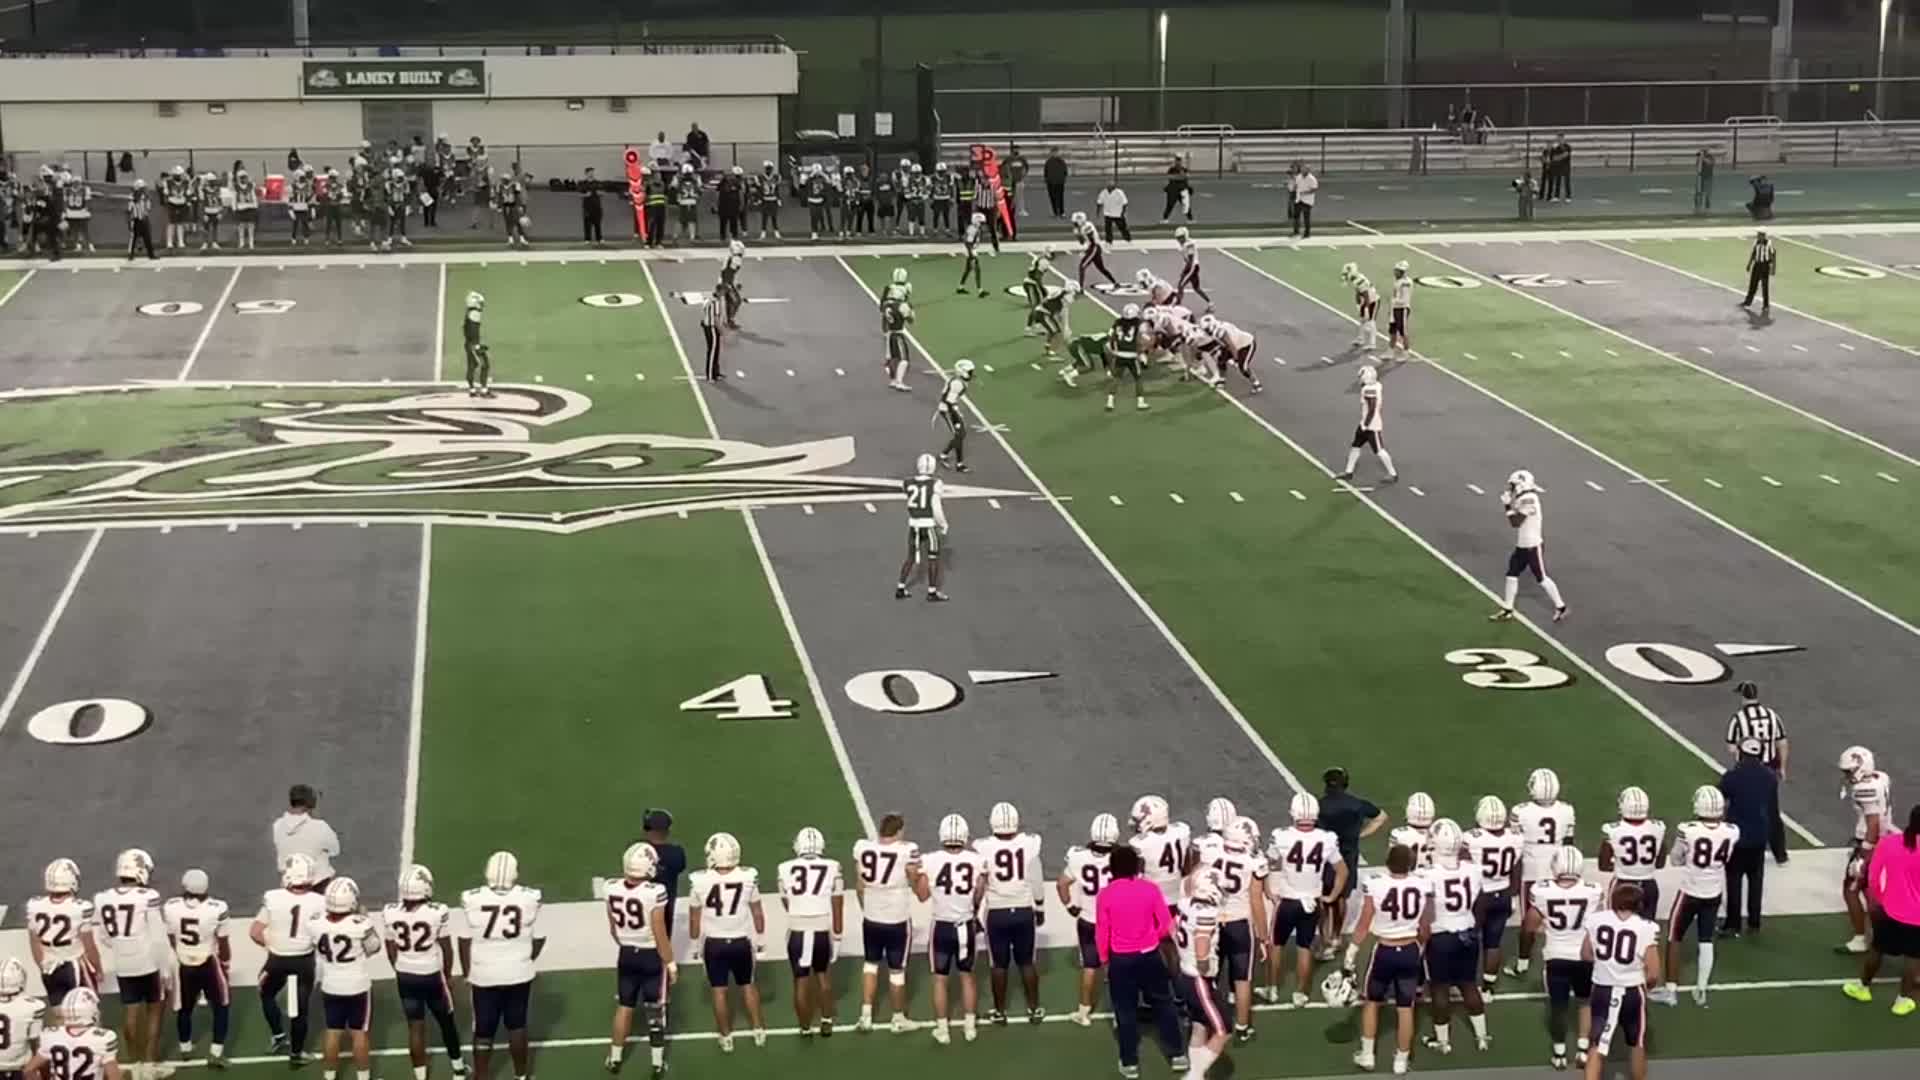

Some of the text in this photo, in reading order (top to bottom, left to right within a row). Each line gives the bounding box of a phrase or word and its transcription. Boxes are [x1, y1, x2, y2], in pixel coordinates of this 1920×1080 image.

[346, 71, 443, 84] LANEY BUILT
[907, 485, 928, 509] 21
[27, 698, 150, 745] 0
[1538, 816, 1557, 844] 3
[860, 850, 898, 885] 97
[994, 847, 1025, 882] 91
[1286, 840, 1324, 874] 44
[1481, 846, 1518, 881] 50
[1619, 834, 1658, 867] 33
[1691, 836, 1730, 869] 84
[789, 864, 828, 897] 37
[935, 861, 974, 896] 43
[1443, 877, 1474, 913] 51
[609, 897, 646, 931] 59
[704, 882, 743, 917] 47
[1380, 887, 1422, 921] 40
[1546, 898, 1589, 932] 57
[34, 912, 73, 948] 22
[100, 903, 135, 938] 87
[179, 917, 201, 947] 5
[288, 905, 301, 939] 1
[391, 920, 433, 954] 32
[480, 904, 523, 940] 73
[317, 934, 354, 964] 42
[1595, 924, 1638, 966] 90
[48, 1044, 96, 1080] 82
